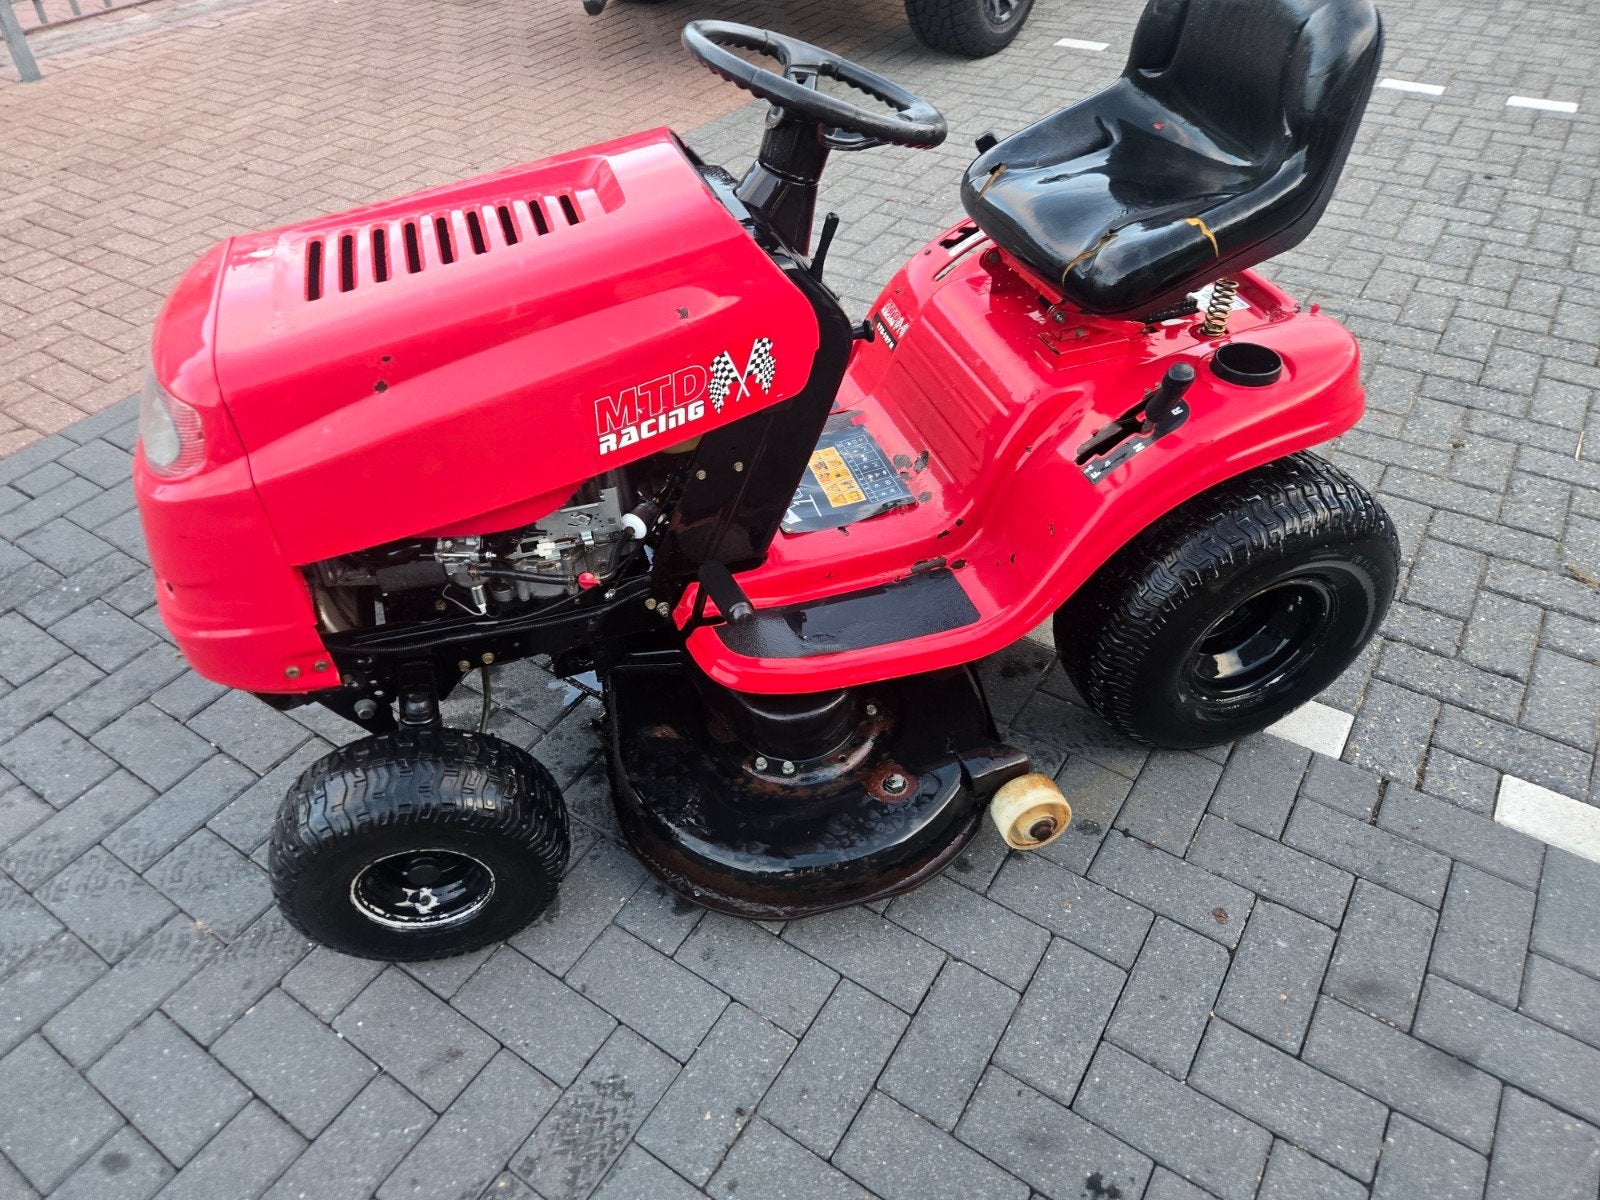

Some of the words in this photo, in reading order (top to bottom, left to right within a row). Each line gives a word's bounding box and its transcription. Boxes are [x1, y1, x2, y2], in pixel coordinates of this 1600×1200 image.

[594, 365, 707, 436] MTD
[1172, 406, 1183, 416] R
[1133, 442, 1145, 452] N
